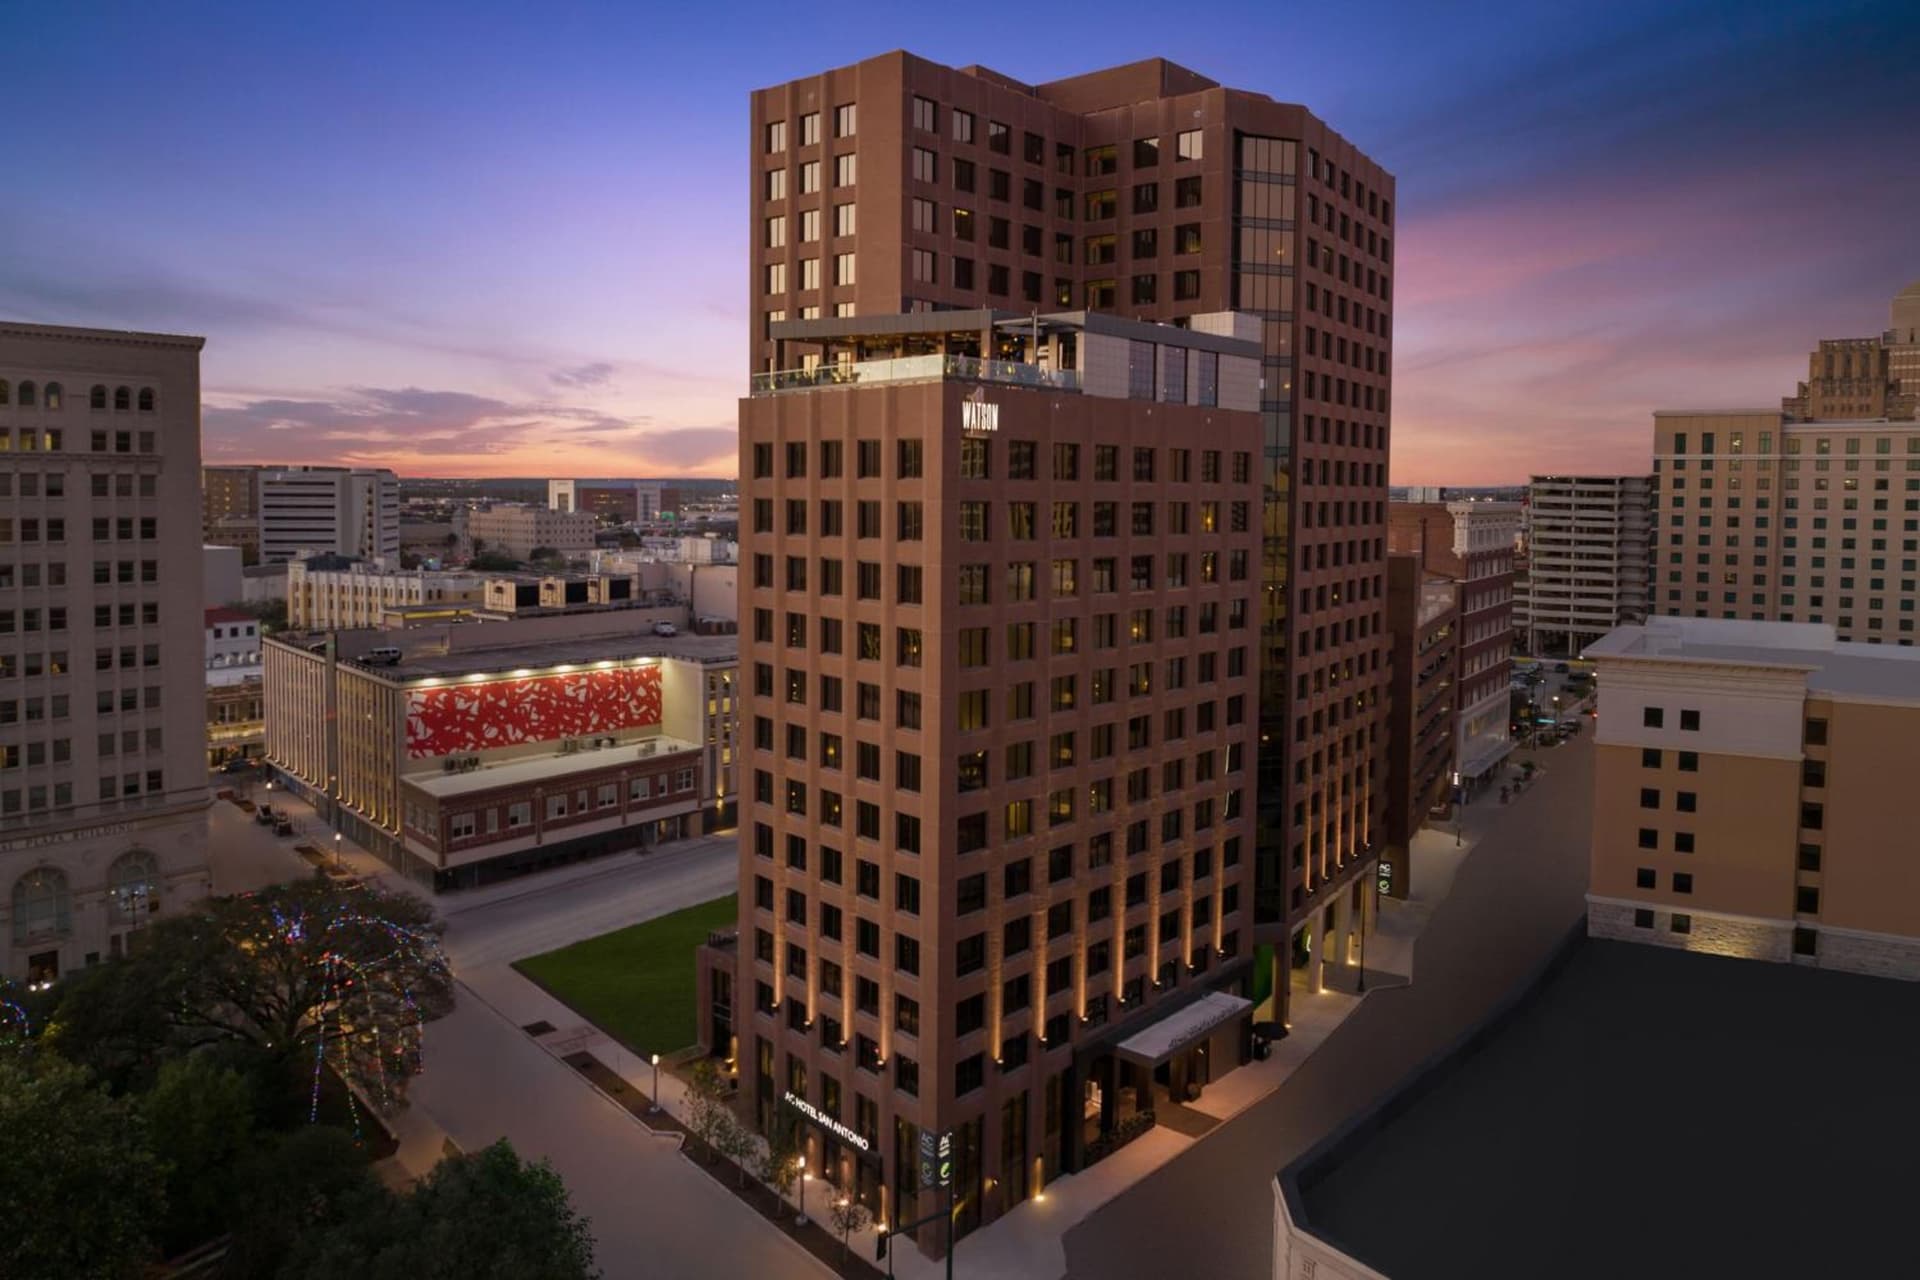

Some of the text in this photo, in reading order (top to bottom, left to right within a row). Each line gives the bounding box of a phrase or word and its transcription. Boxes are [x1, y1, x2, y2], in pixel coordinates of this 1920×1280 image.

[962, 401, 999, 431] WATSON
[25, 834, 64, 849] PLAZA
[72, 823, 135, 841] BUILDING
[795, 1097, 818, 1120] HOTEL
[818, 1111, 833, 1129] SAN
[833, 1120, 869, 1151] ANTONIO
